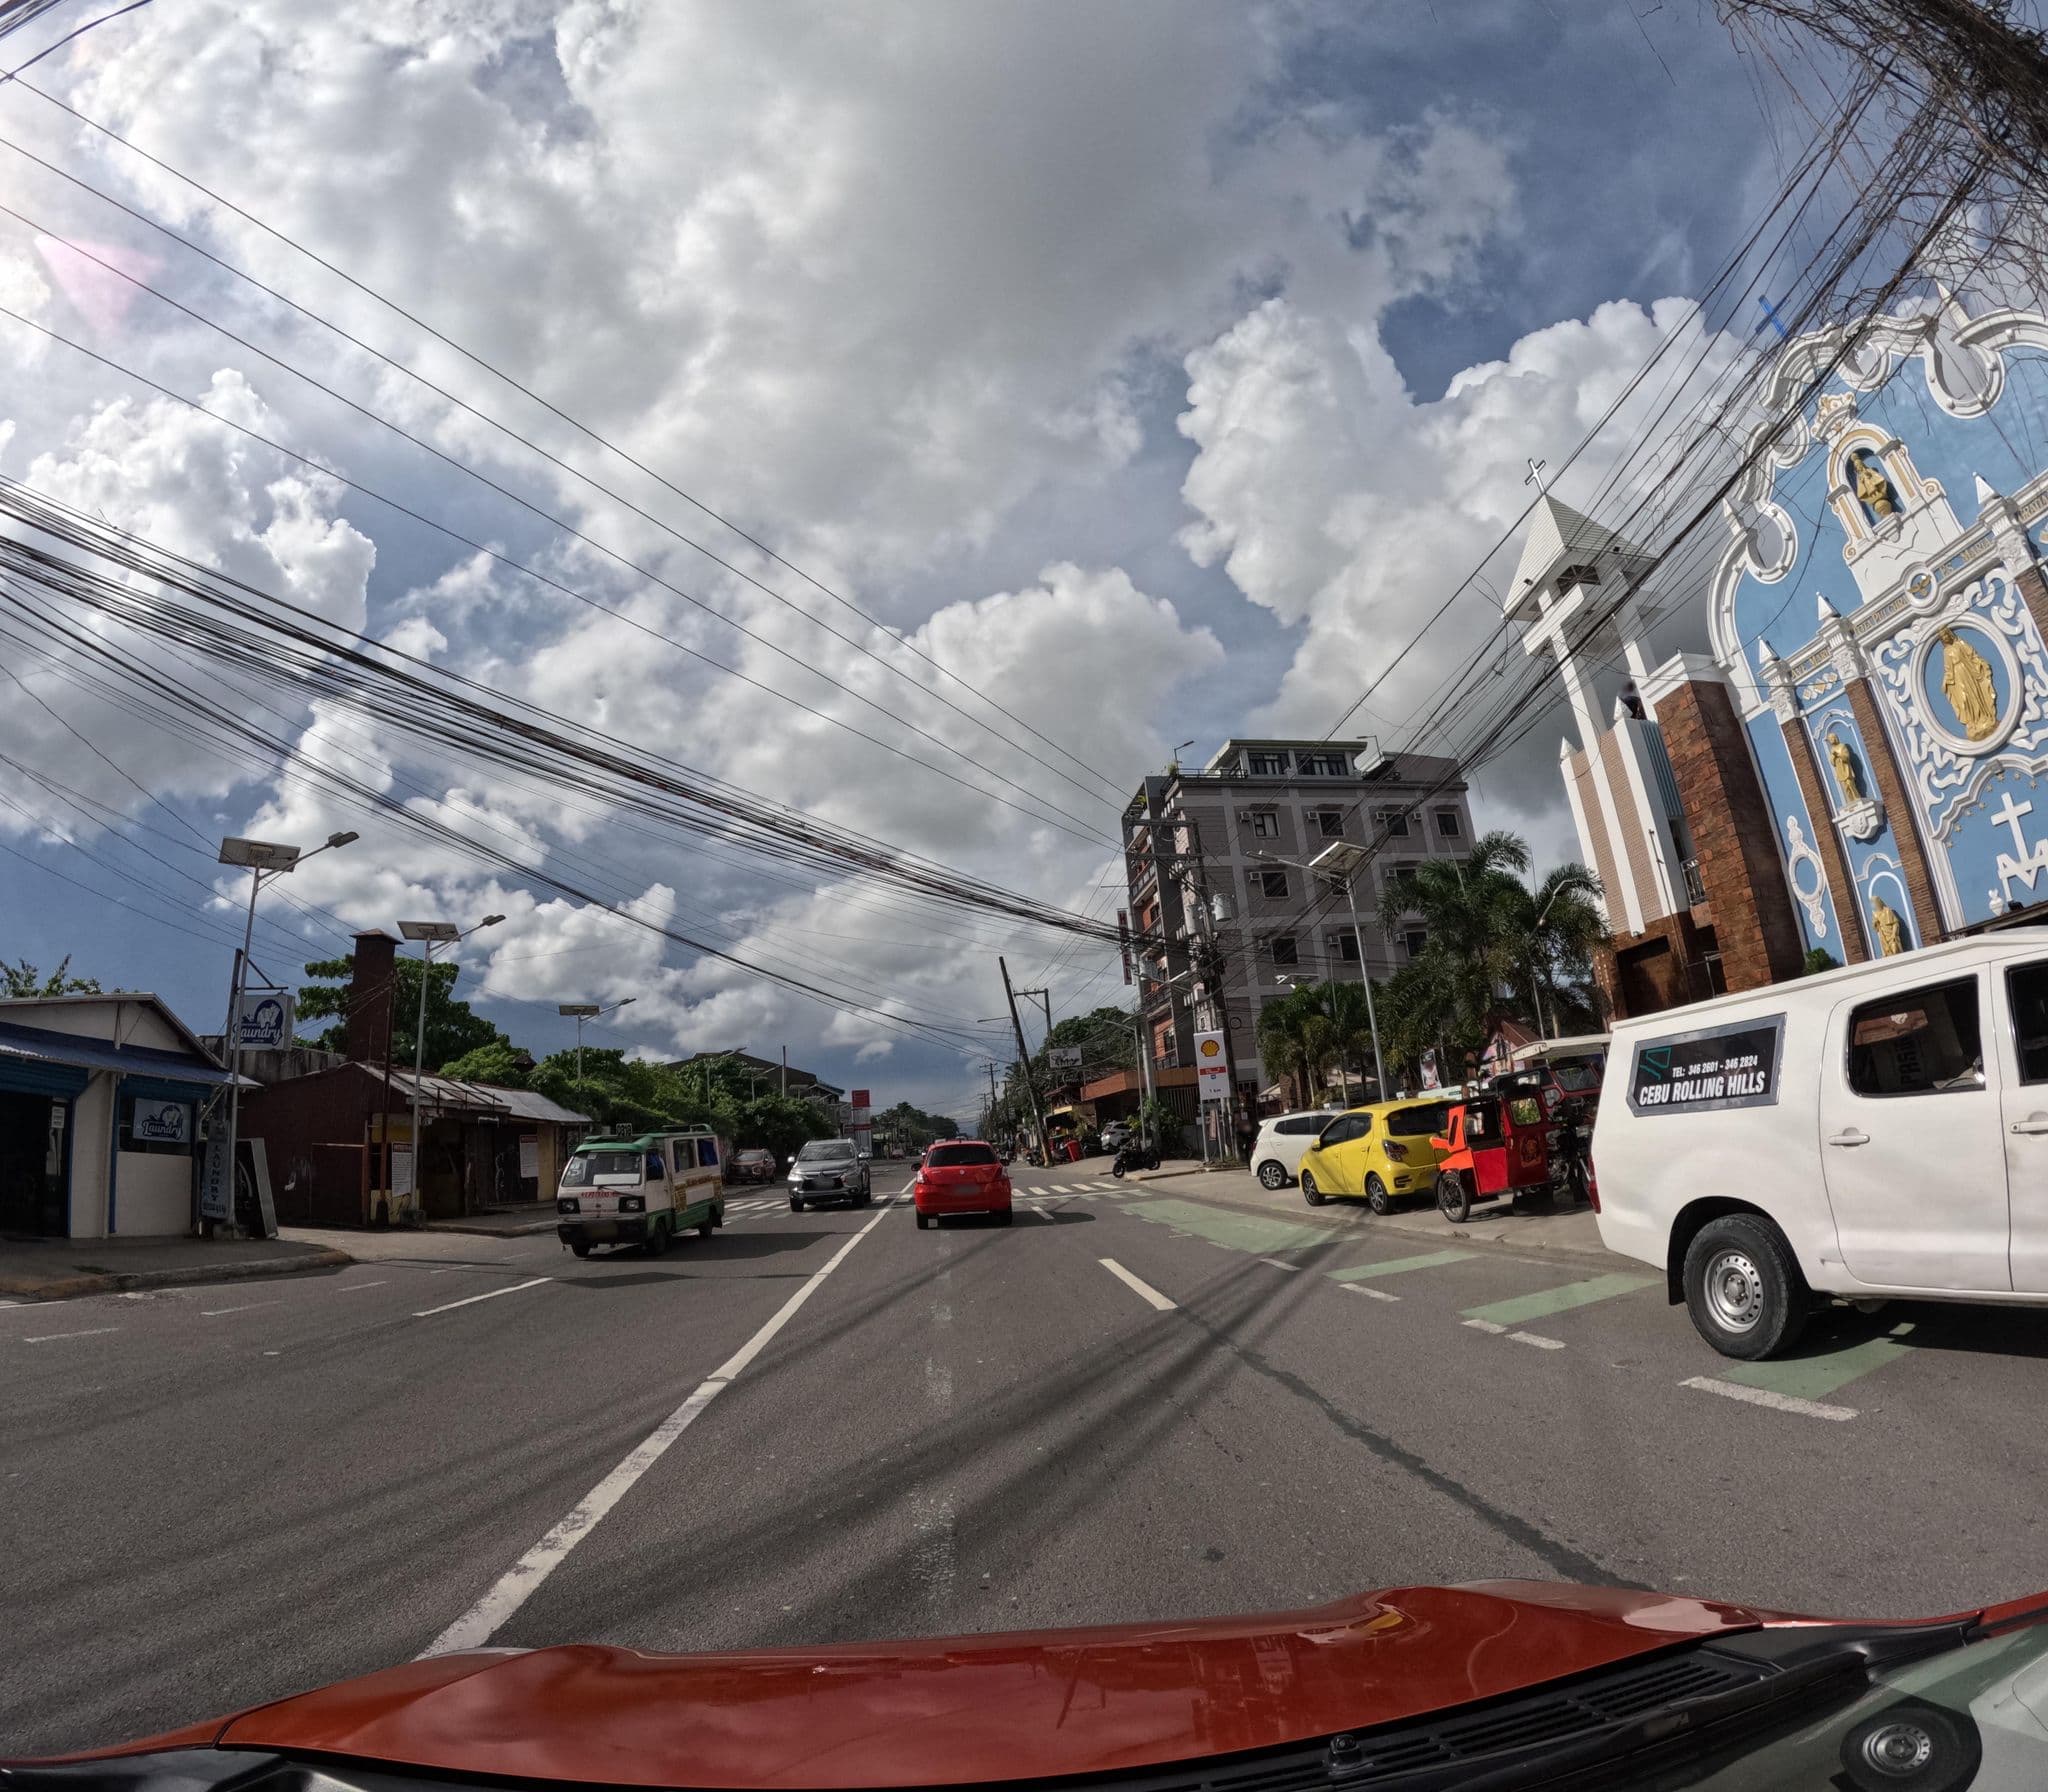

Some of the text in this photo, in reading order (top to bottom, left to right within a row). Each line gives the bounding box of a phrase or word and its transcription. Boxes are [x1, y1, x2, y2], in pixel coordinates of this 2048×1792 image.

[1791, 663, 1805, 678] AVE
[1809, 649, 1829, 666] MARI
[1961, 538, 1991, 561] MARIA
[1672, 1067, 1686, 1078] TEL:
[1688, 1064, 1701, 1075] 346
[1702, 1060, 1718, 1073] 2601
[1725, 1057, 1738, 1070] 346
[1739, 1055, 1758, 1068] 2824
[1639, 1070, 1766, 1105] CEBU ROLLING HILLS
[143, 1120, 182, 1140] Laundry
[211, 1145, 221, 1201] LAUNDRY
